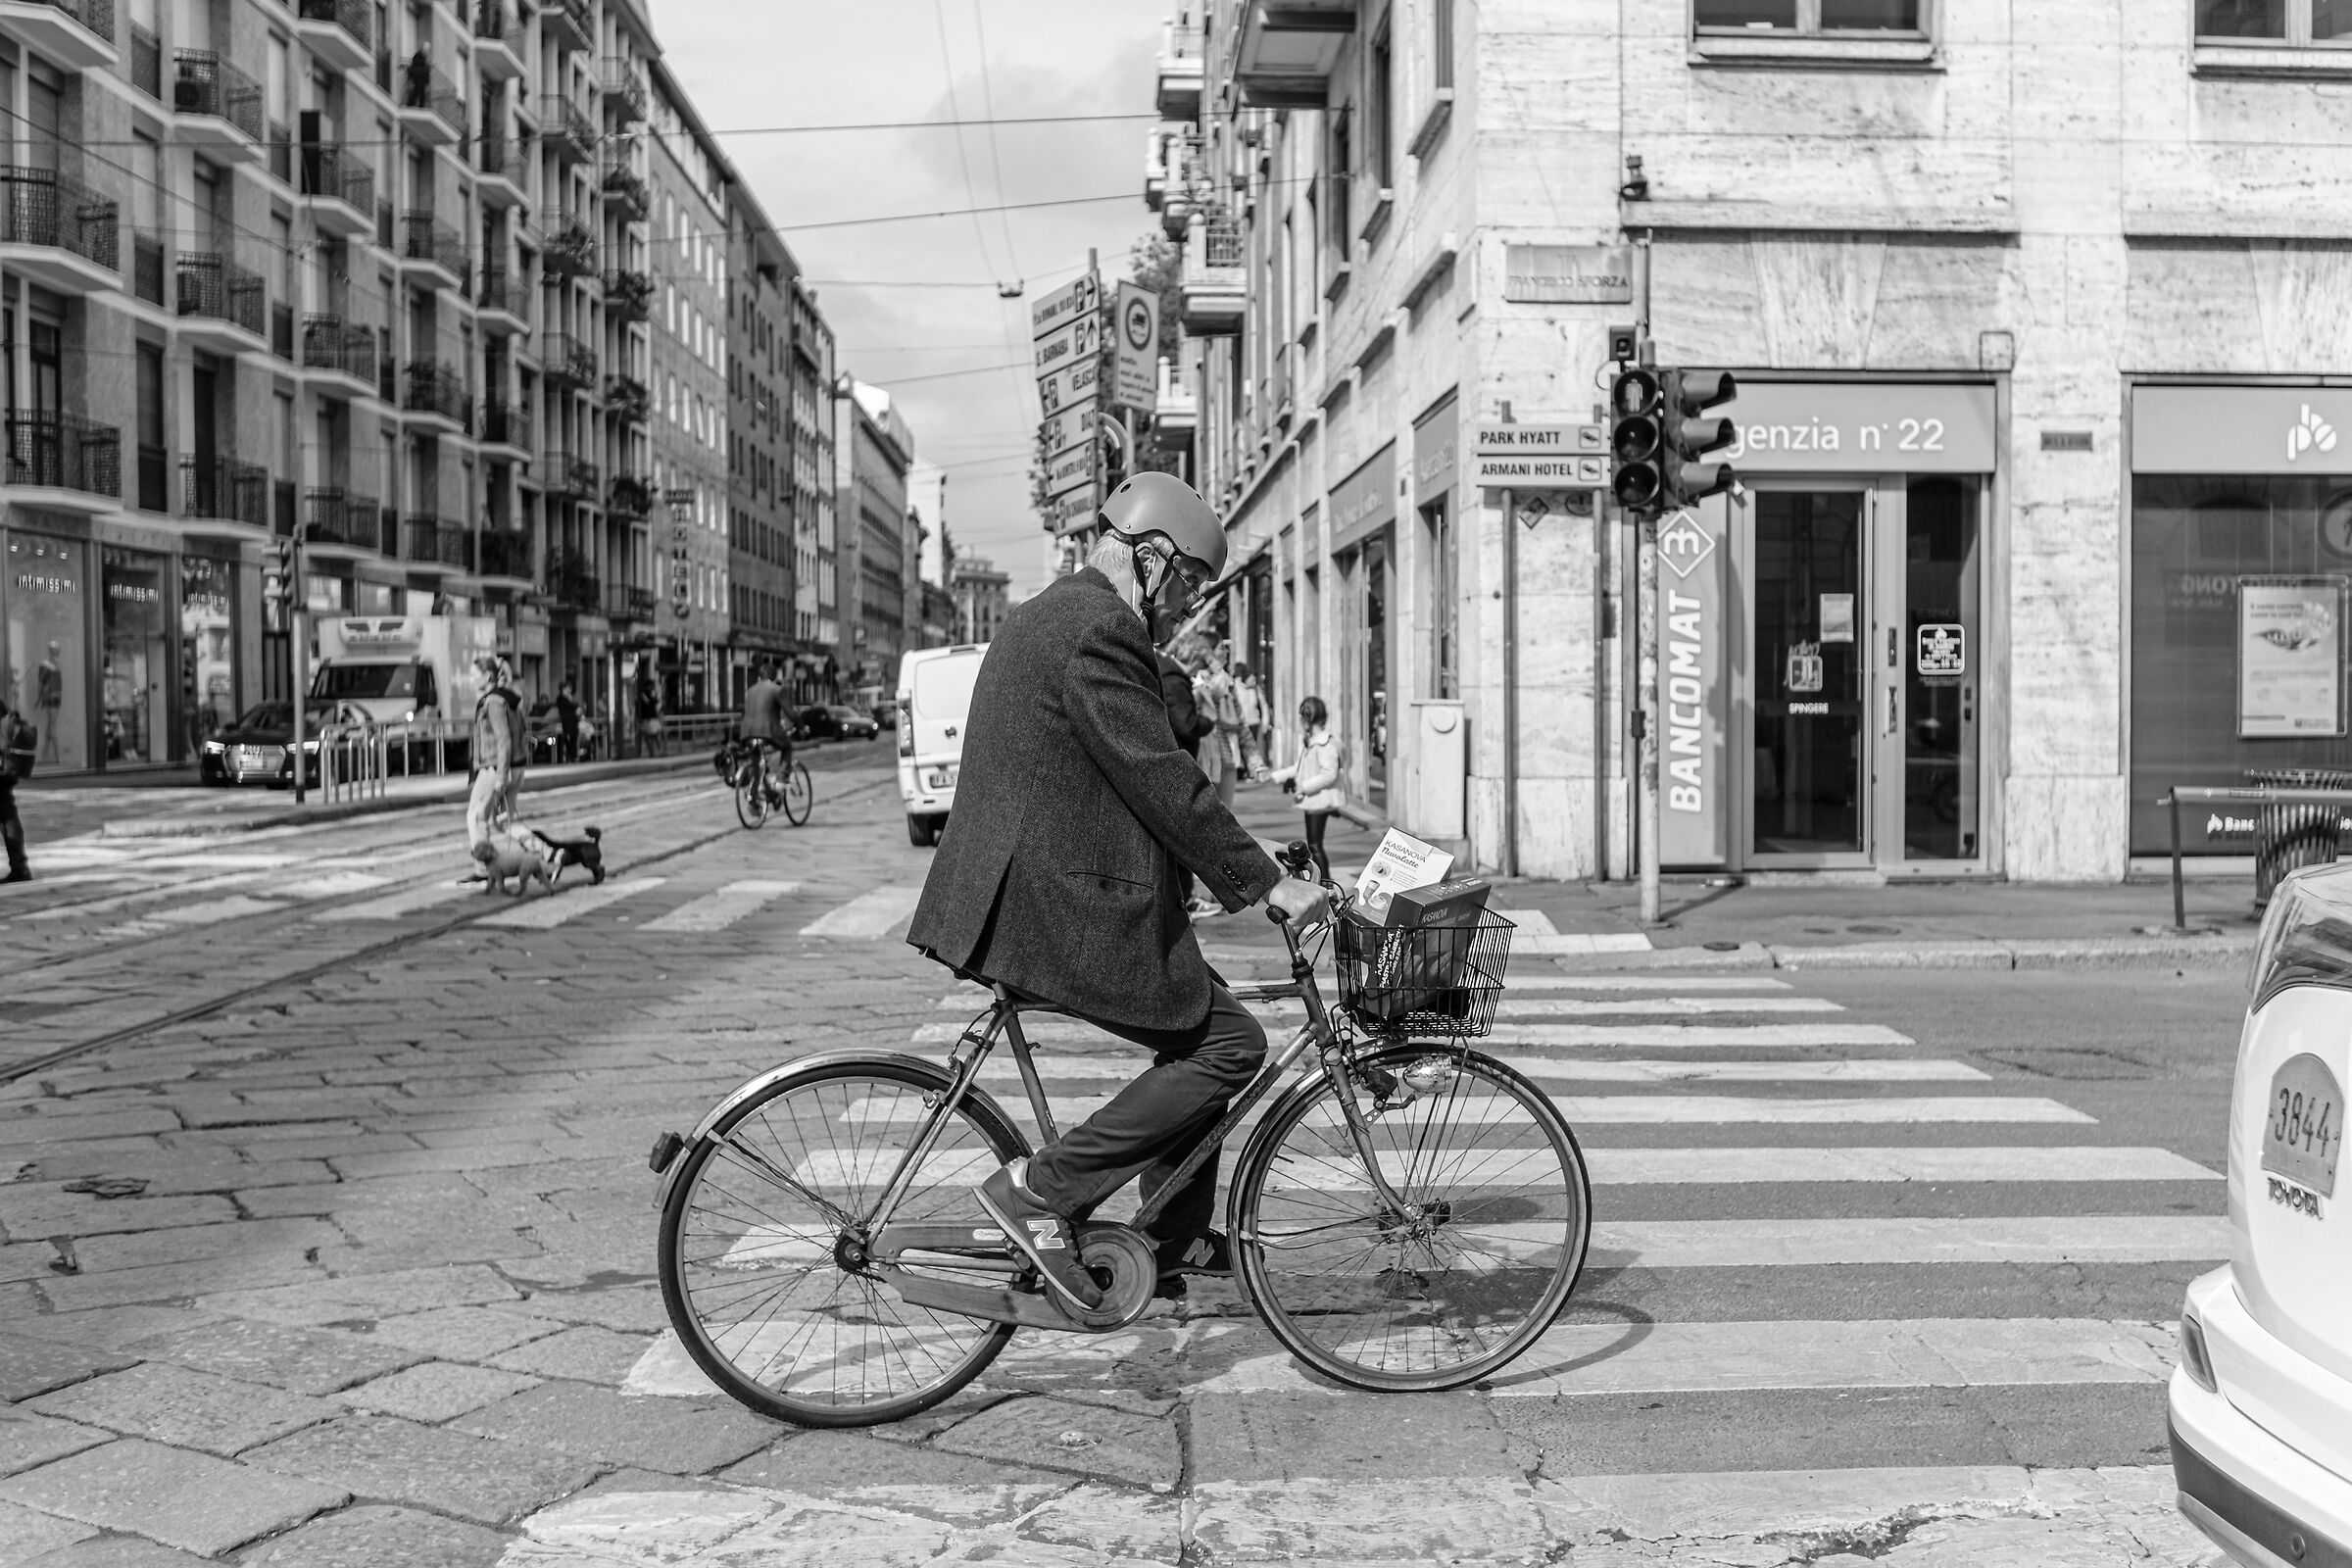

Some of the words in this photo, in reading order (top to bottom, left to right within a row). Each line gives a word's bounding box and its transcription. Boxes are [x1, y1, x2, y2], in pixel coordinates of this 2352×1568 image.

[1578, 274, 1628, 287] SFORZA
[1480, 430, 1515, 445] PARK
[1519, 430, 1561, 445] HYATT
[1724, 416, 1840, 460] genzia
[1897, 417, 1945, 452] 22
[1481, 463, 1531, 477] ARMANI
[1535, 463, 1574, 477] HOTEL
[18, 573, 76, 595] intimissimi
[110, 583, 160, 604] intimissimi
[1668, 588, 1702, 812] BANCOMAT
[1788, 702, 1830, 714] SPINGERE
[2224, 815, 2256, 832] Banc
[1385, 840, 1427, 863] KASANOVA
[2274, 1087, 2331, 1158] 3844
[2268, 1177, 2323, 1220] TOYOTA
